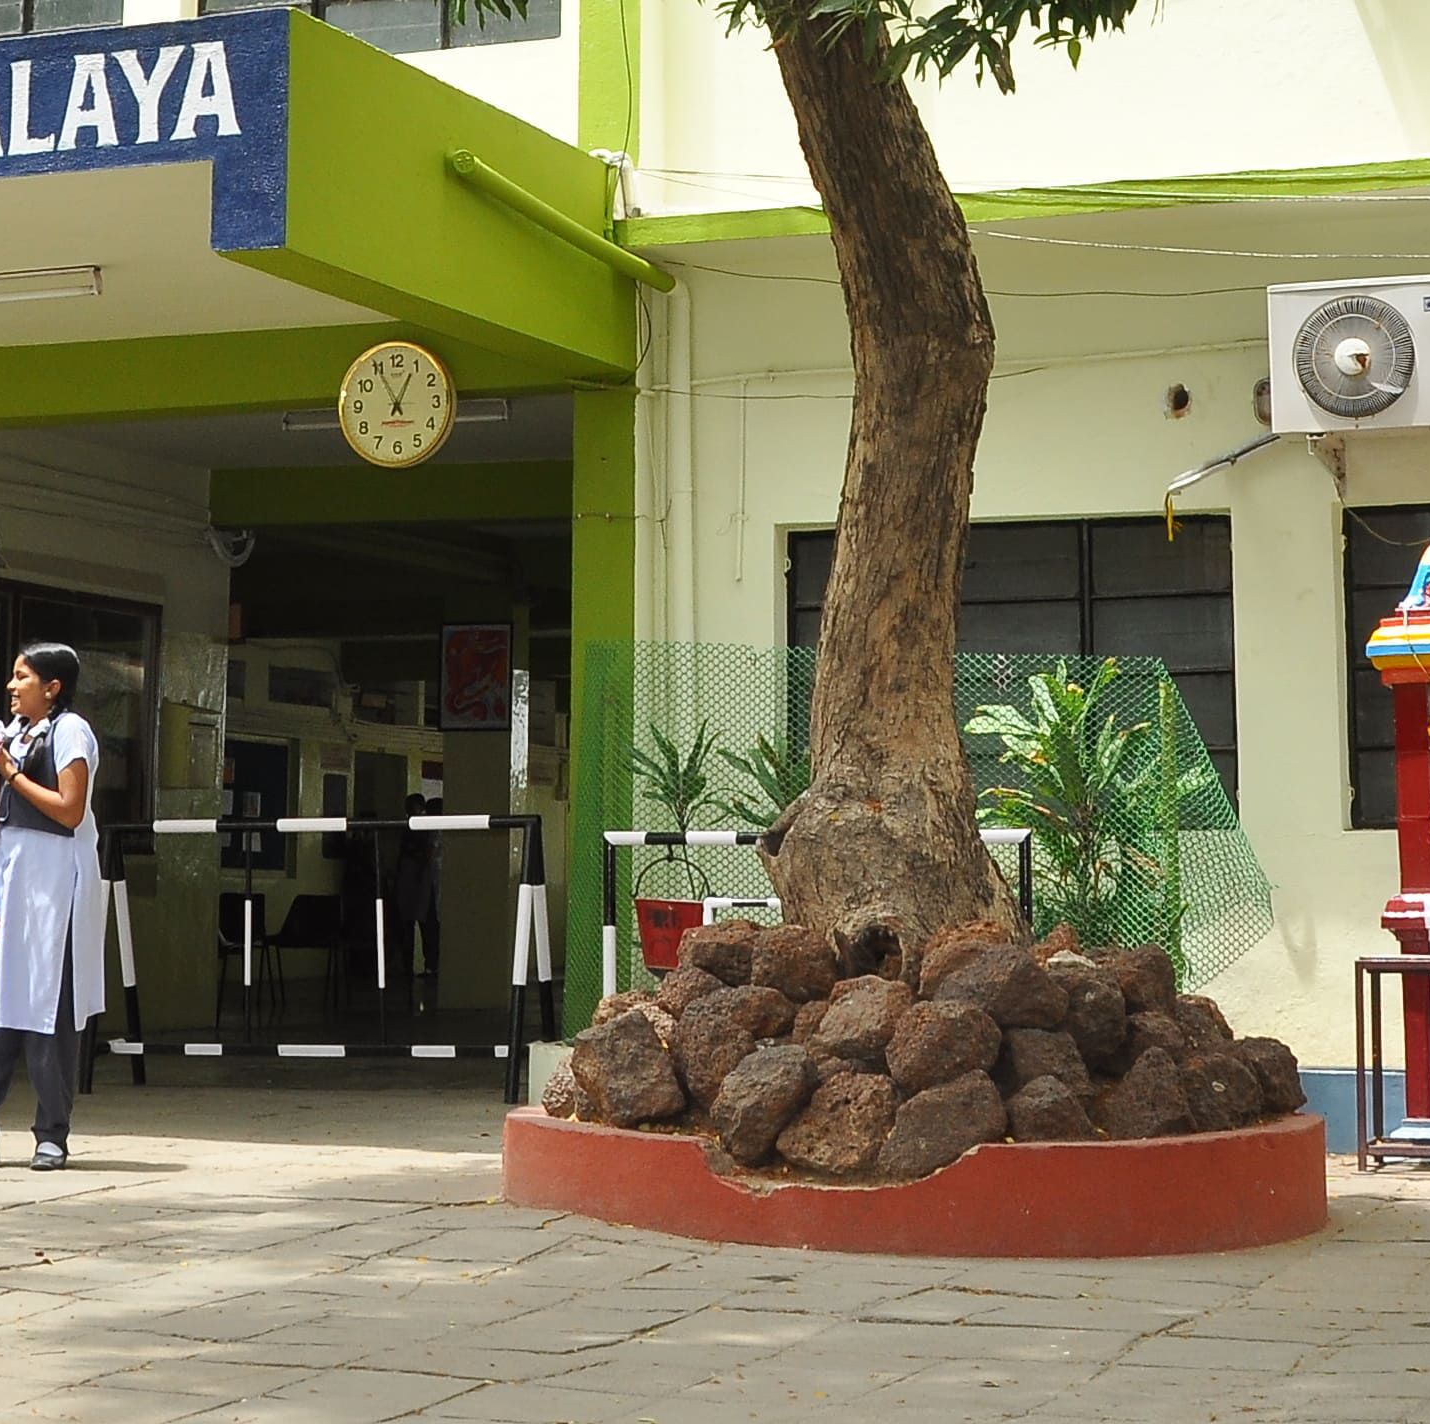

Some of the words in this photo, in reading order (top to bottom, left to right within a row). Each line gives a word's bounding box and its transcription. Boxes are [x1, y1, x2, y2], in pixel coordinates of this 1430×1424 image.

[372, 360, 384, 375] 11
[389, 353, 404, 368] 12
[413, 359, 419, 373] 1
[358, 378, 373, 393] 10
[426, 373, 436, 387] 2
[353, 399, 363, 414] 9
[432, 394, 441, 409] 3
[359, 421, 369, 435] 8
[425, 416, 435, 430] 4
[373, 435, 383, 450] 7
[392, 440, 403, 455] 6
[412, 433, 422, 448] 5
